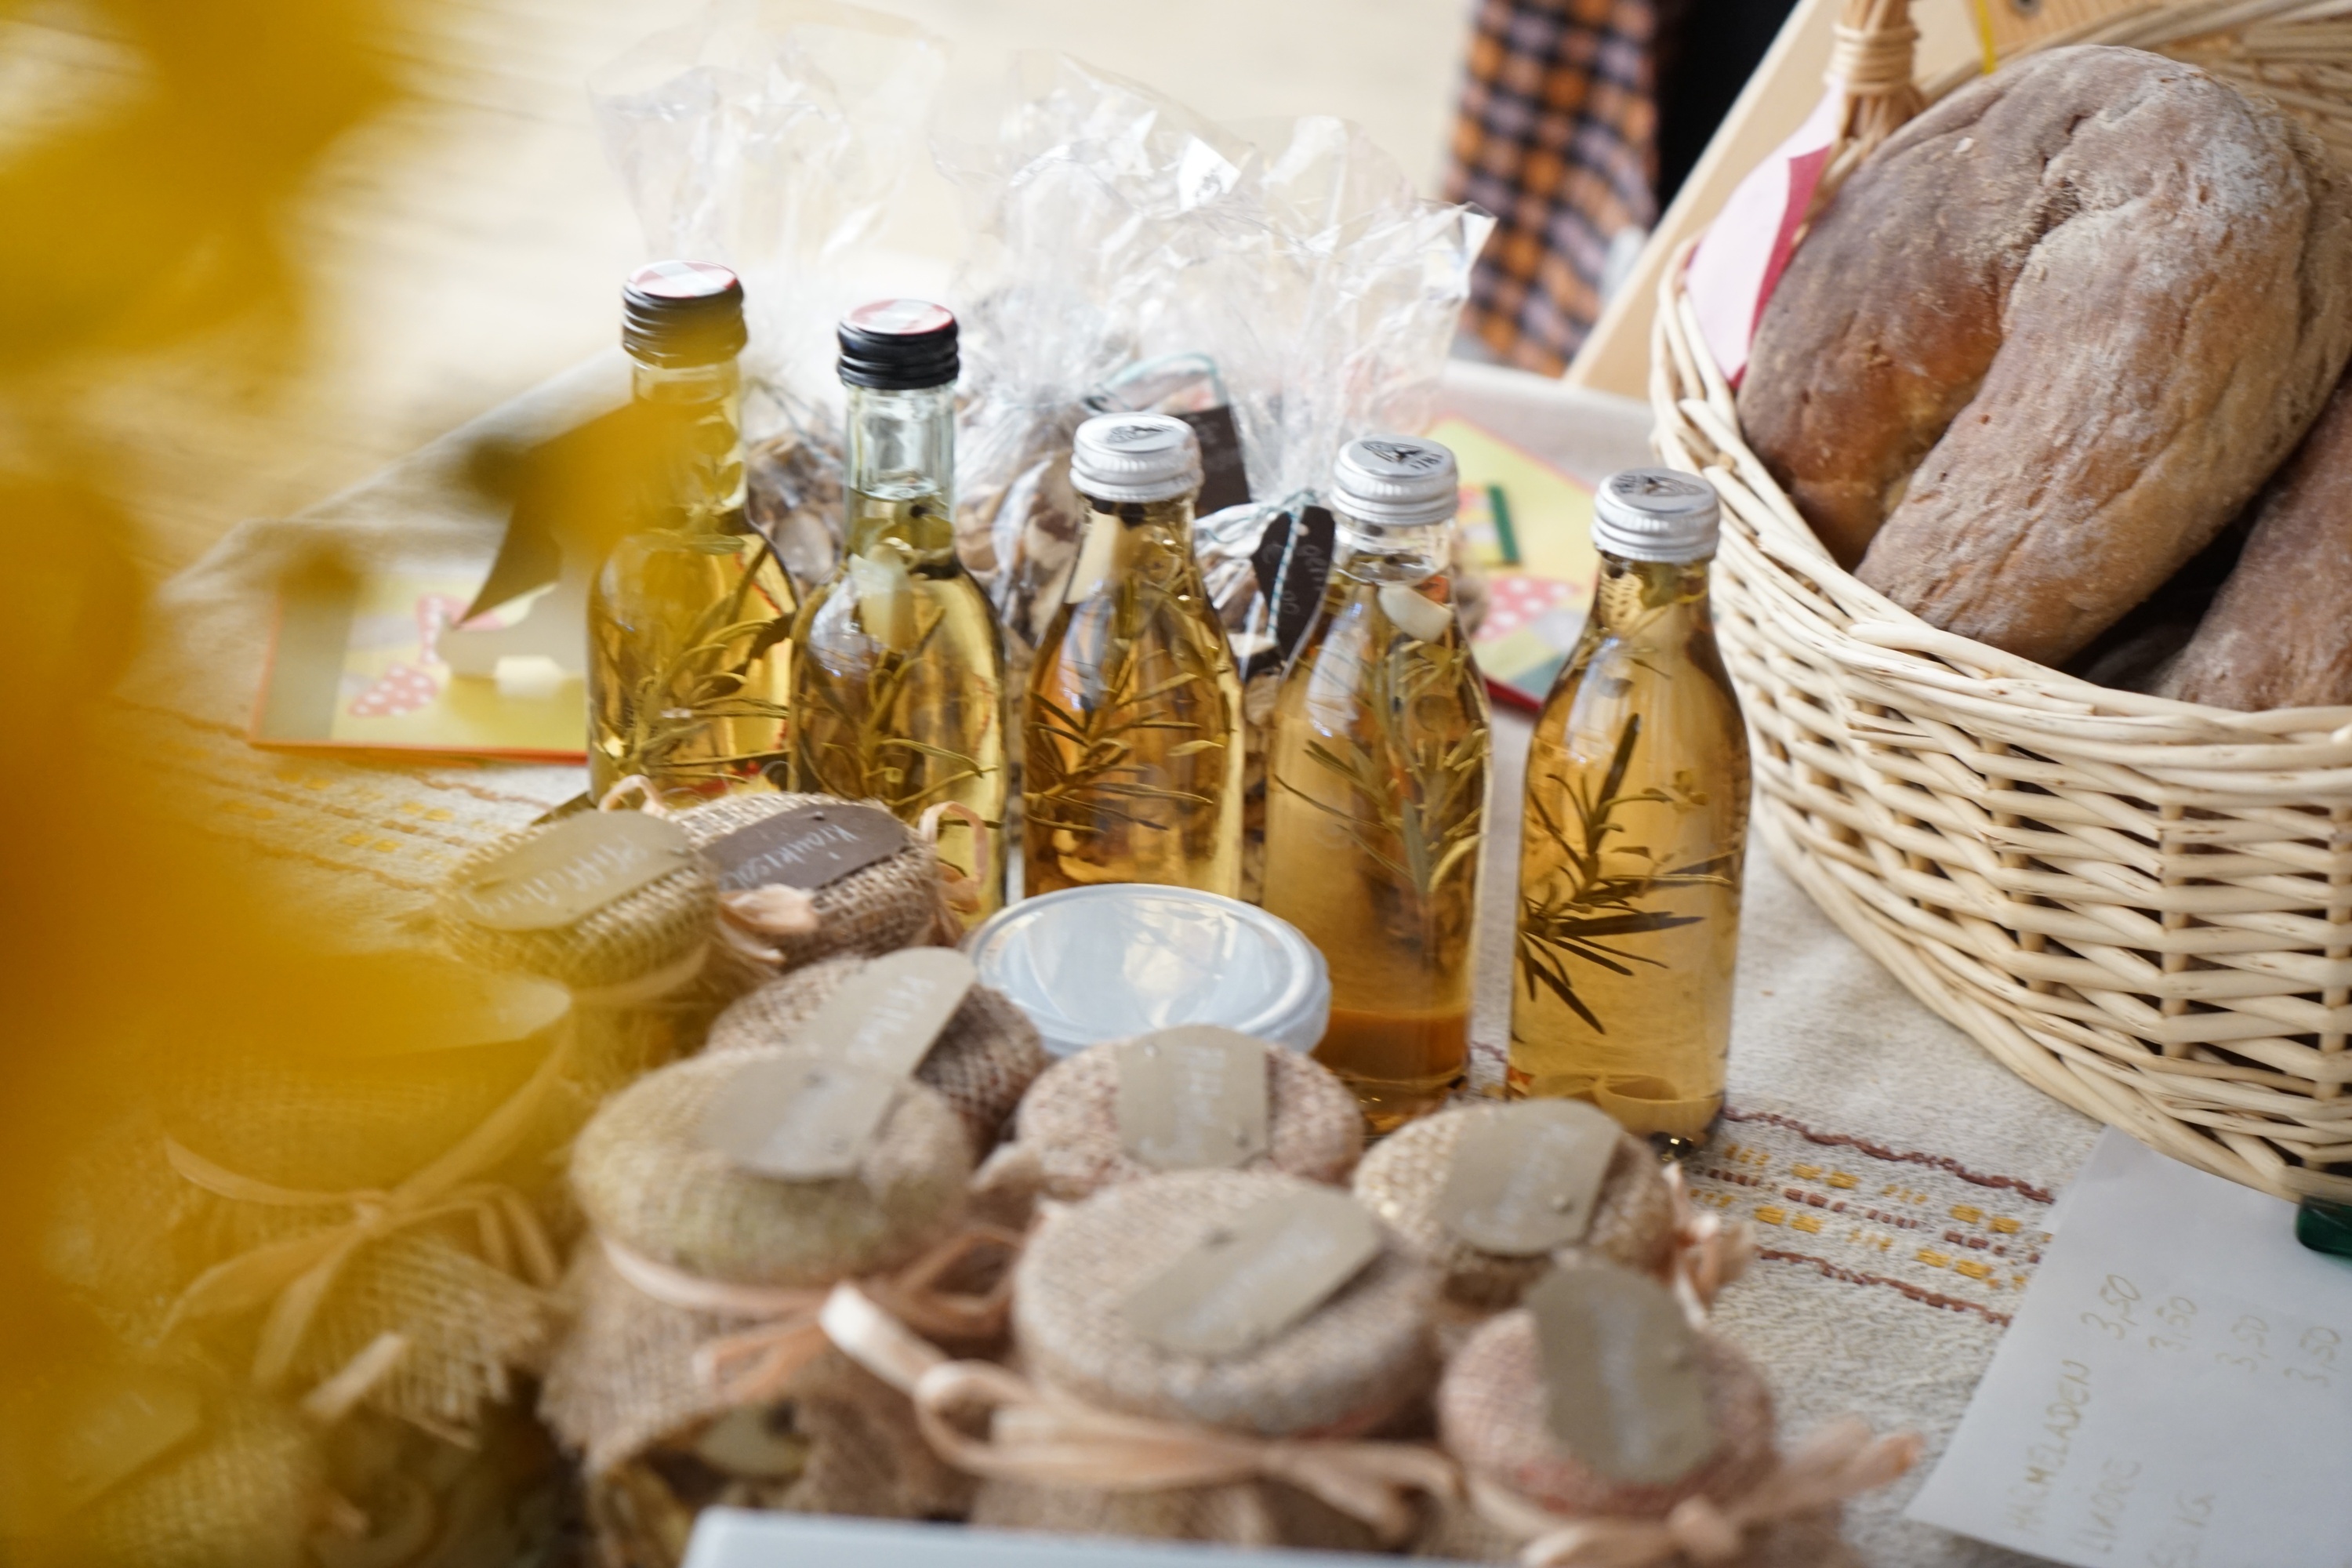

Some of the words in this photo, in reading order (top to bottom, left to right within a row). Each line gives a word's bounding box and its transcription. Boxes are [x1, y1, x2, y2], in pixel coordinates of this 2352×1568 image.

[2079, 1273, 2142, 1341] 3,50
[2147, 1295, 2198, 1353] 3,50
[2215, 1314, 2271, 1373] 3,50
[2282, 1325, 2343, 1388] 3,50
